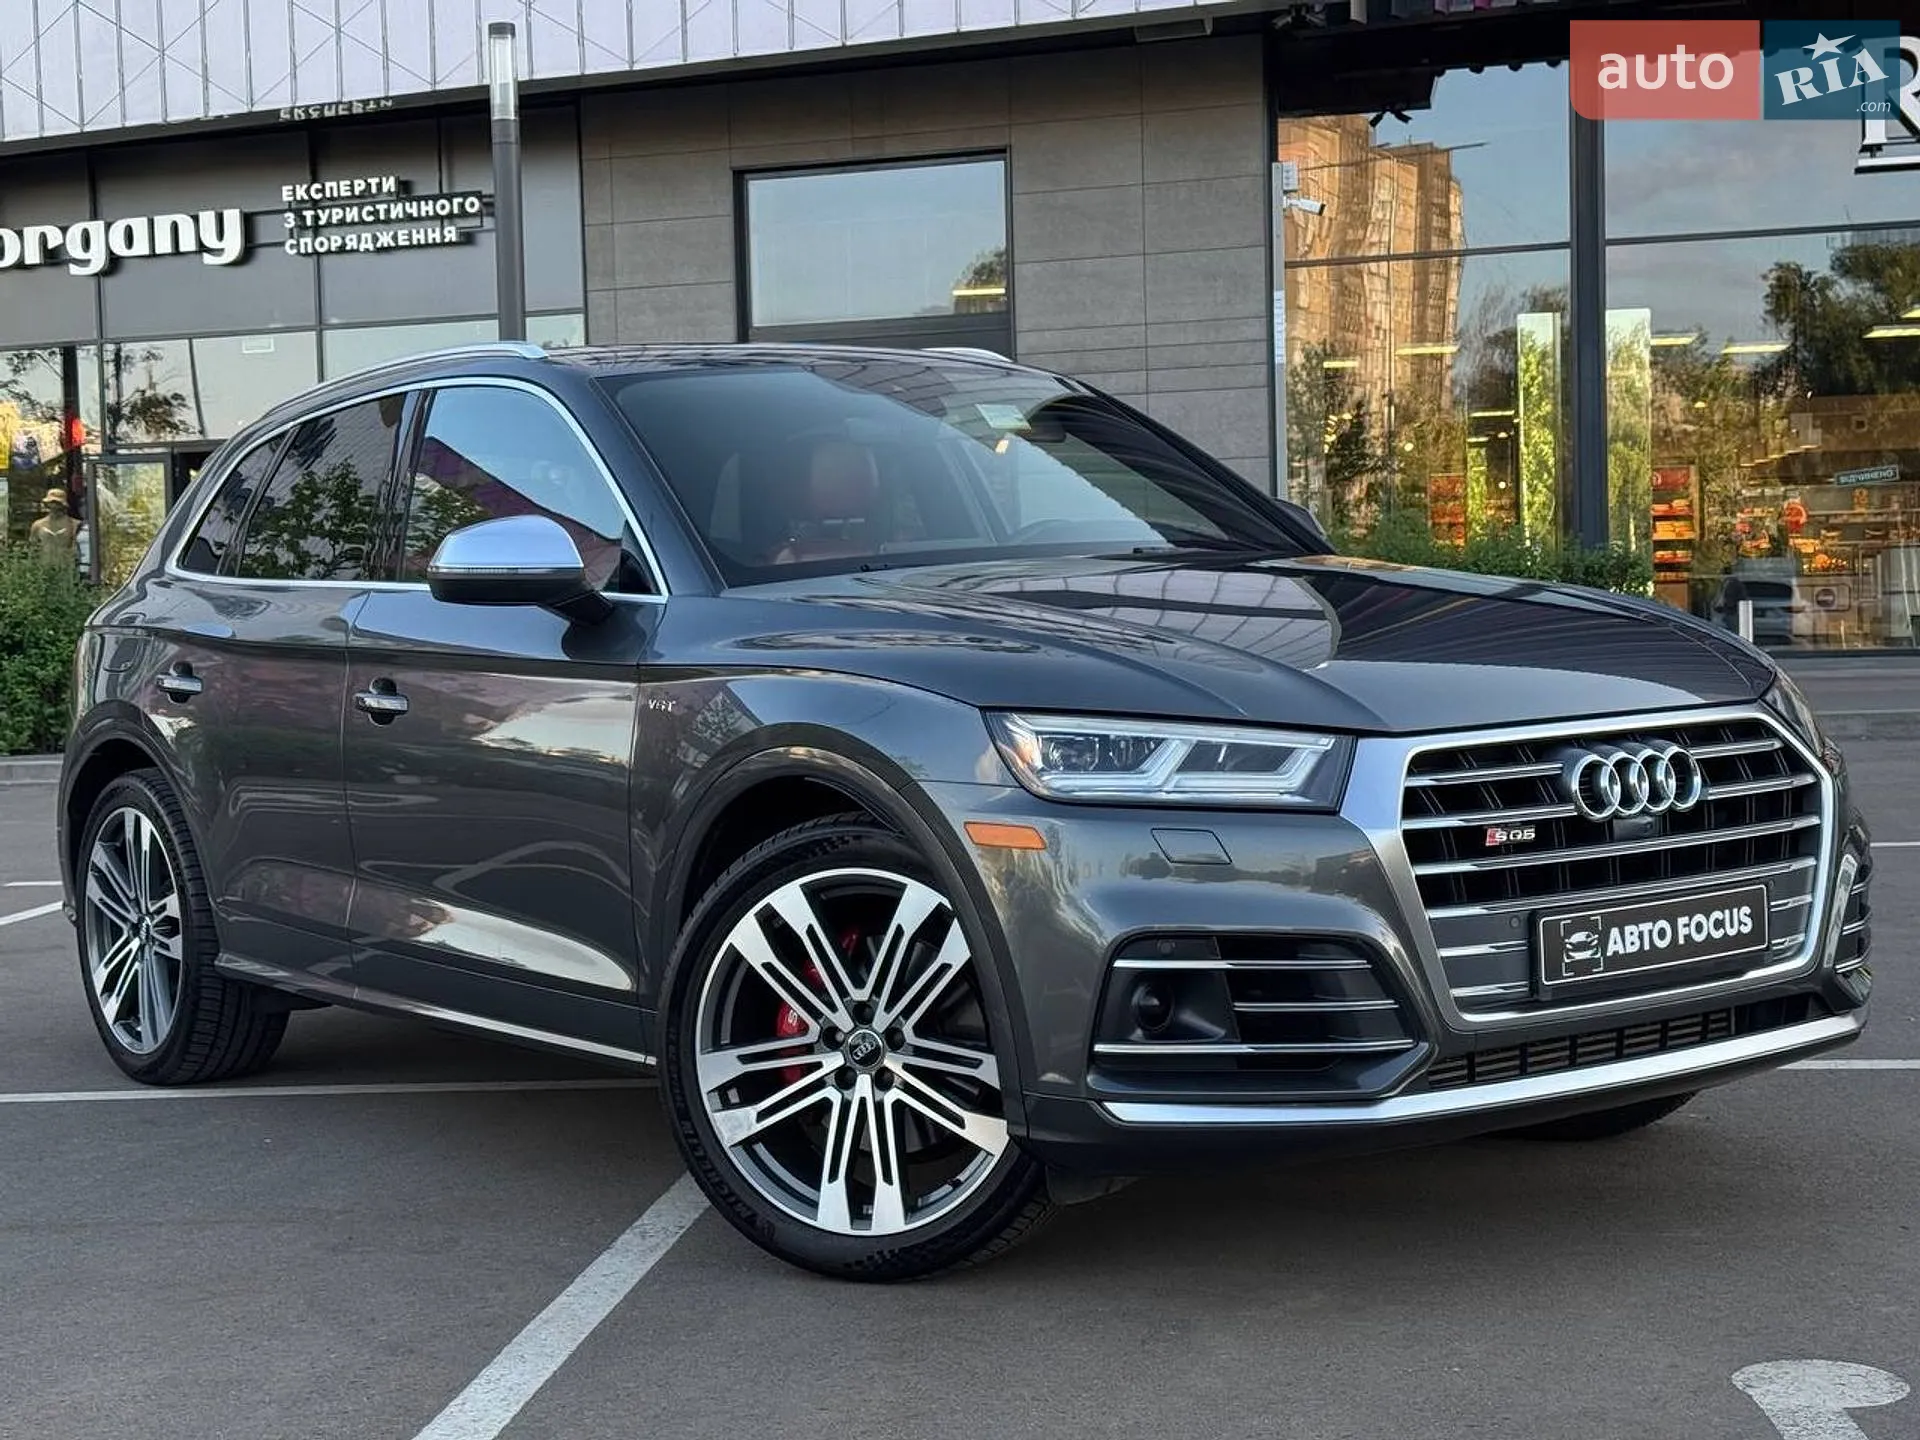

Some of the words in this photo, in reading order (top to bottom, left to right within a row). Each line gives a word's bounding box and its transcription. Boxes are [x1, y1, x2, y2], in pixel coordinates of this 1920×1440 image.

[281, 175, 397, 202] ЕКСПЕРТИ
[303, 196, 481, 228] ТУРИСТИЧНОГО
[284, 226, 458, 256] СПОРЯДЖЕННЯ
[1606, 919, 1671, 957] АВТО
[1678, 905, 1754, 945] FOCUS
